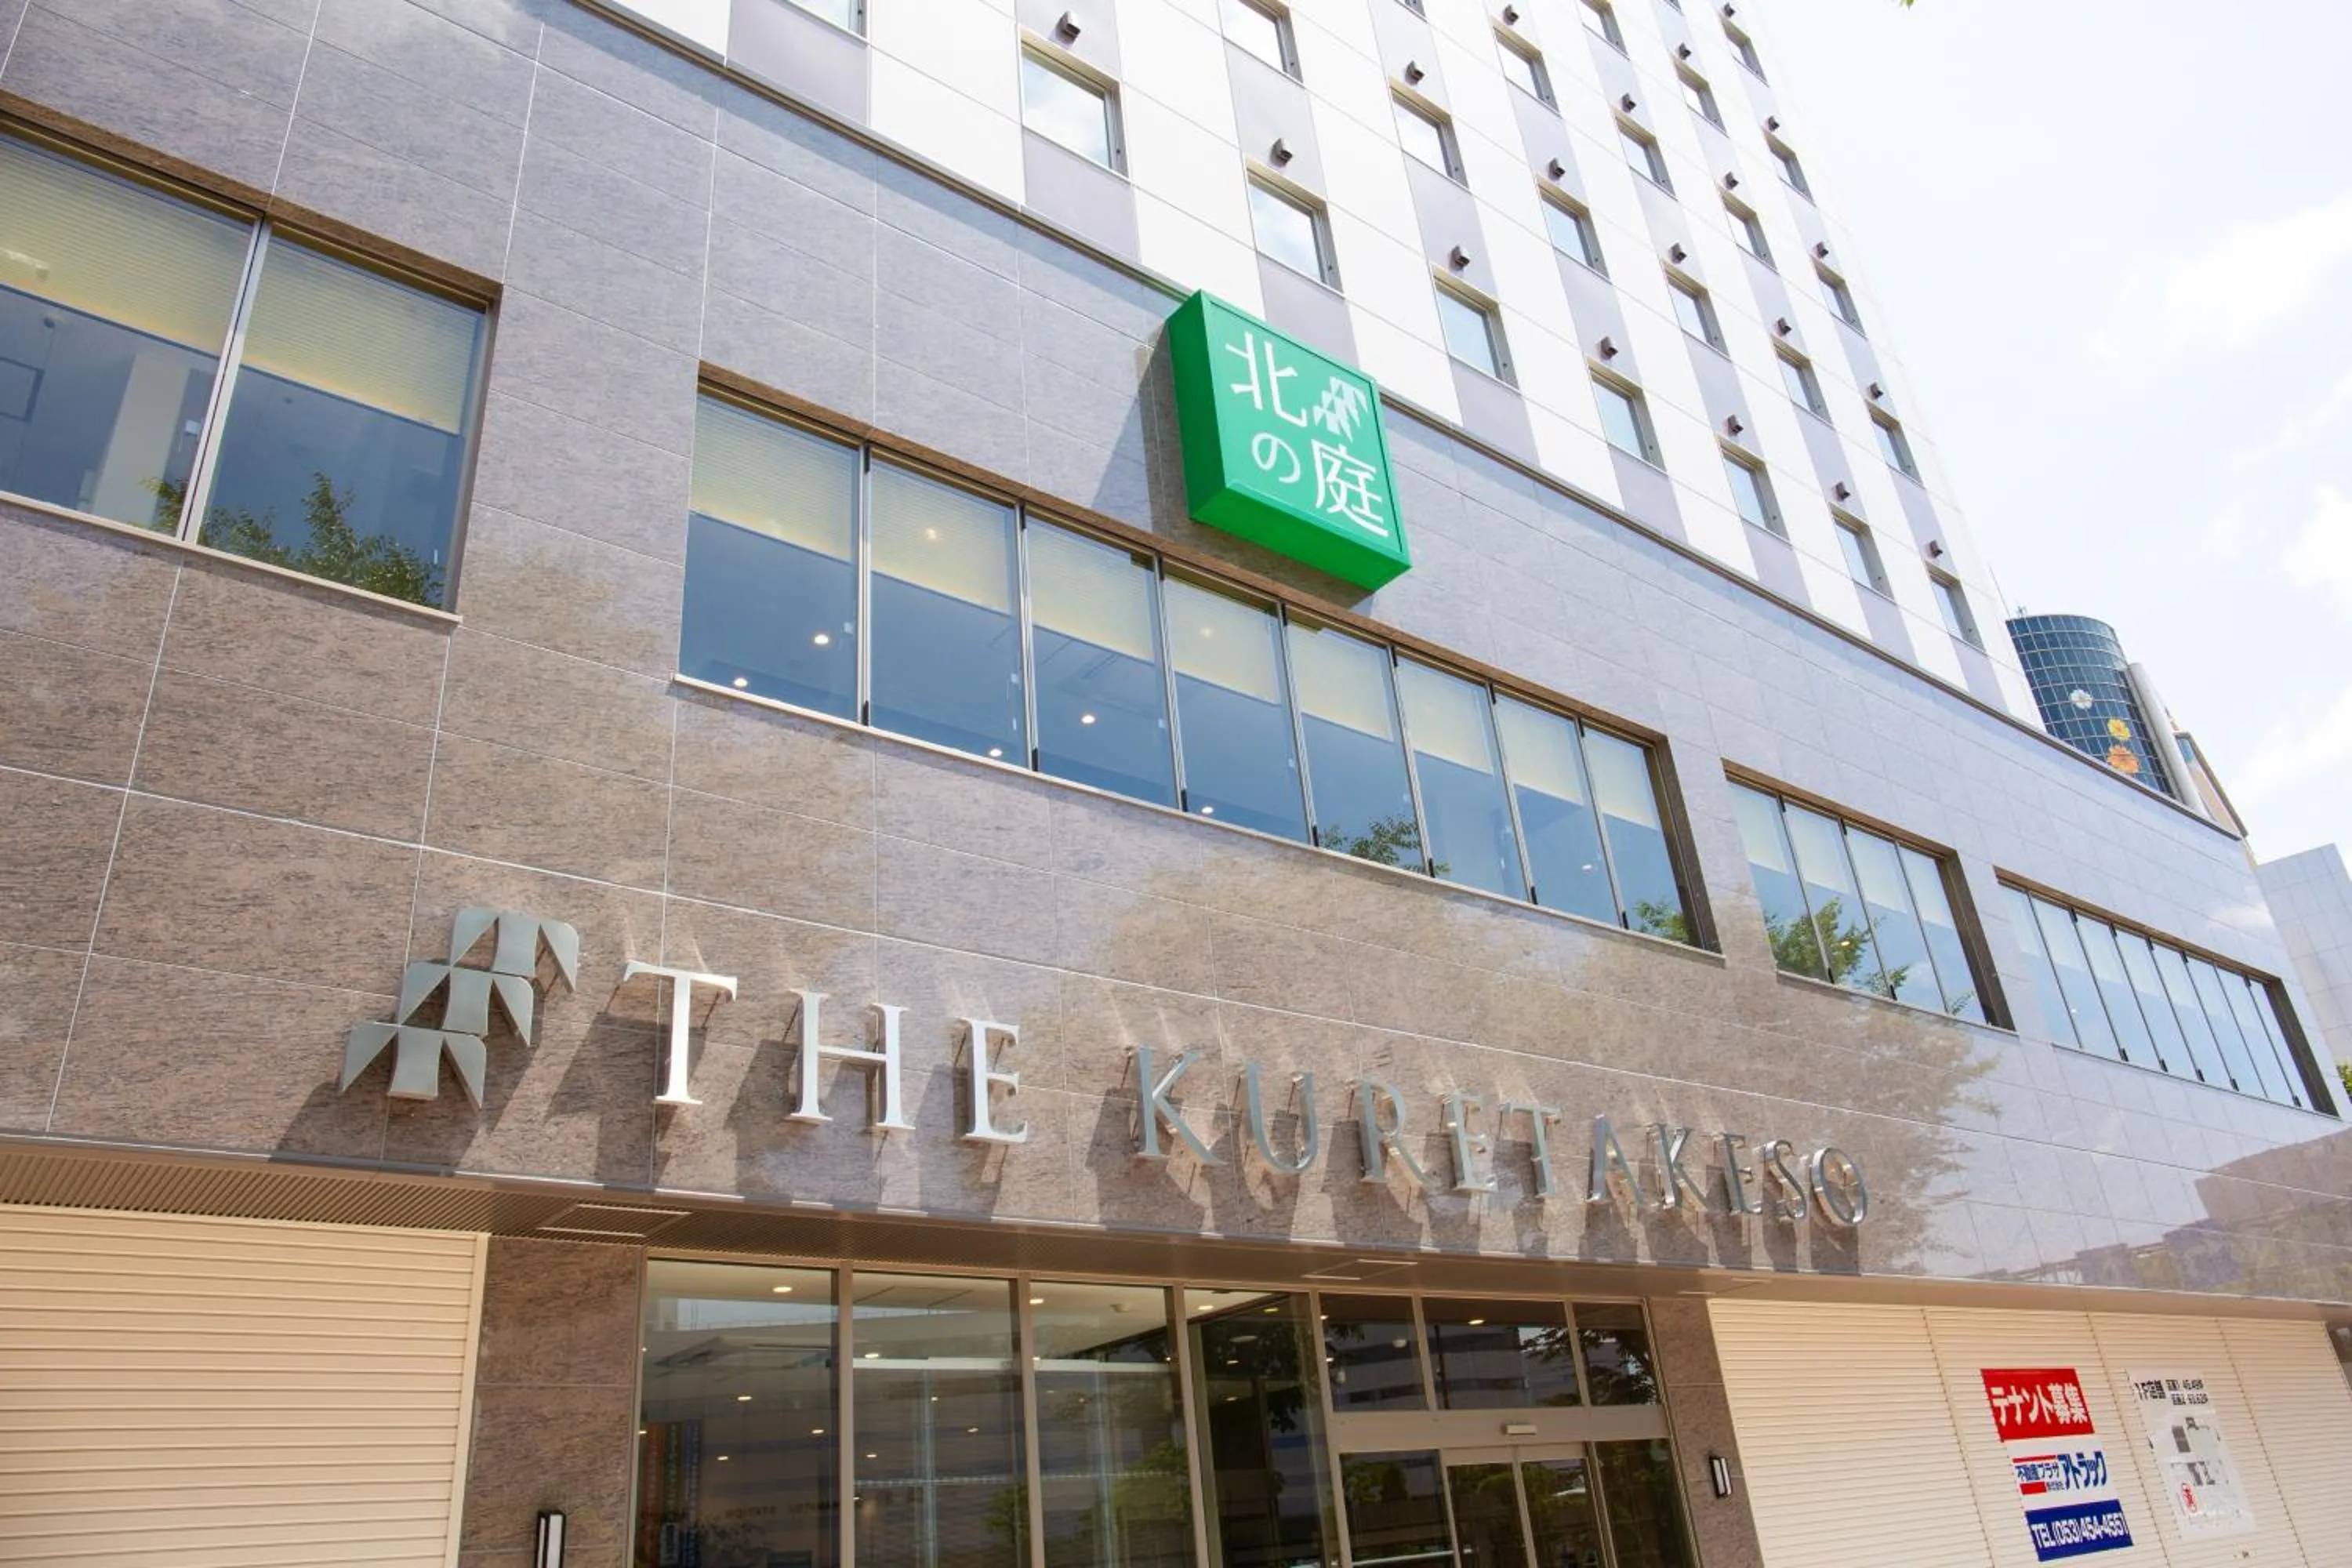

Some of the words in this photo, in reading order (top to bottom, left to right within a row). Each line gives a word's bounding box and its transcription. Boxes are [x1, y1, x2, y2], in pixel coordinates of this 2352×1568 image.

[1225, 332, 1308, 427] 北
[624, 960, 1029, 1145] THE
[1137, 1045, 1869, 1228] KURETAKESO
[1991, 1382, 2089, 1427] テナント募集
